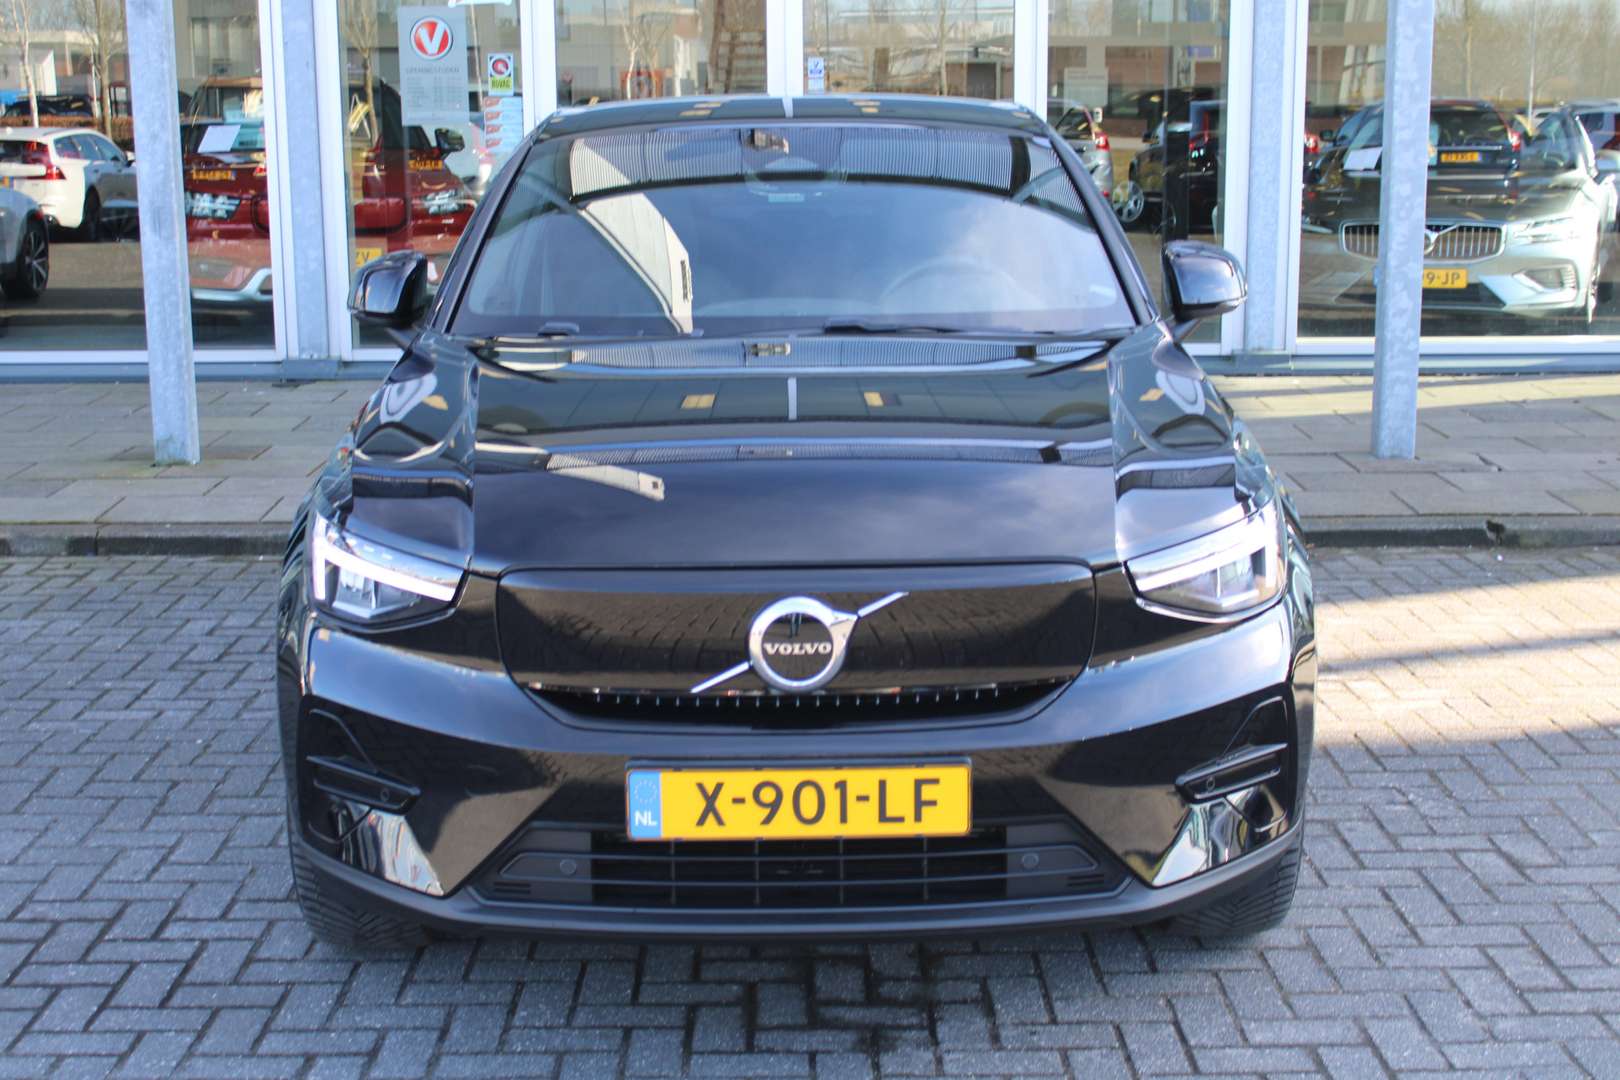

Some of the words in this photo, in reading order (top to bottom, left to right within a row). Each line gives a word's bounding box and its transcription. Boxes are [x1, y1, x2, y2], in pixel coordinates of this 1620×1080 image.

[763, 641, 832, 656] VOLVO
[695, 778, 941, 827] X-901-LF
[634, 810, 657, 827] NL
